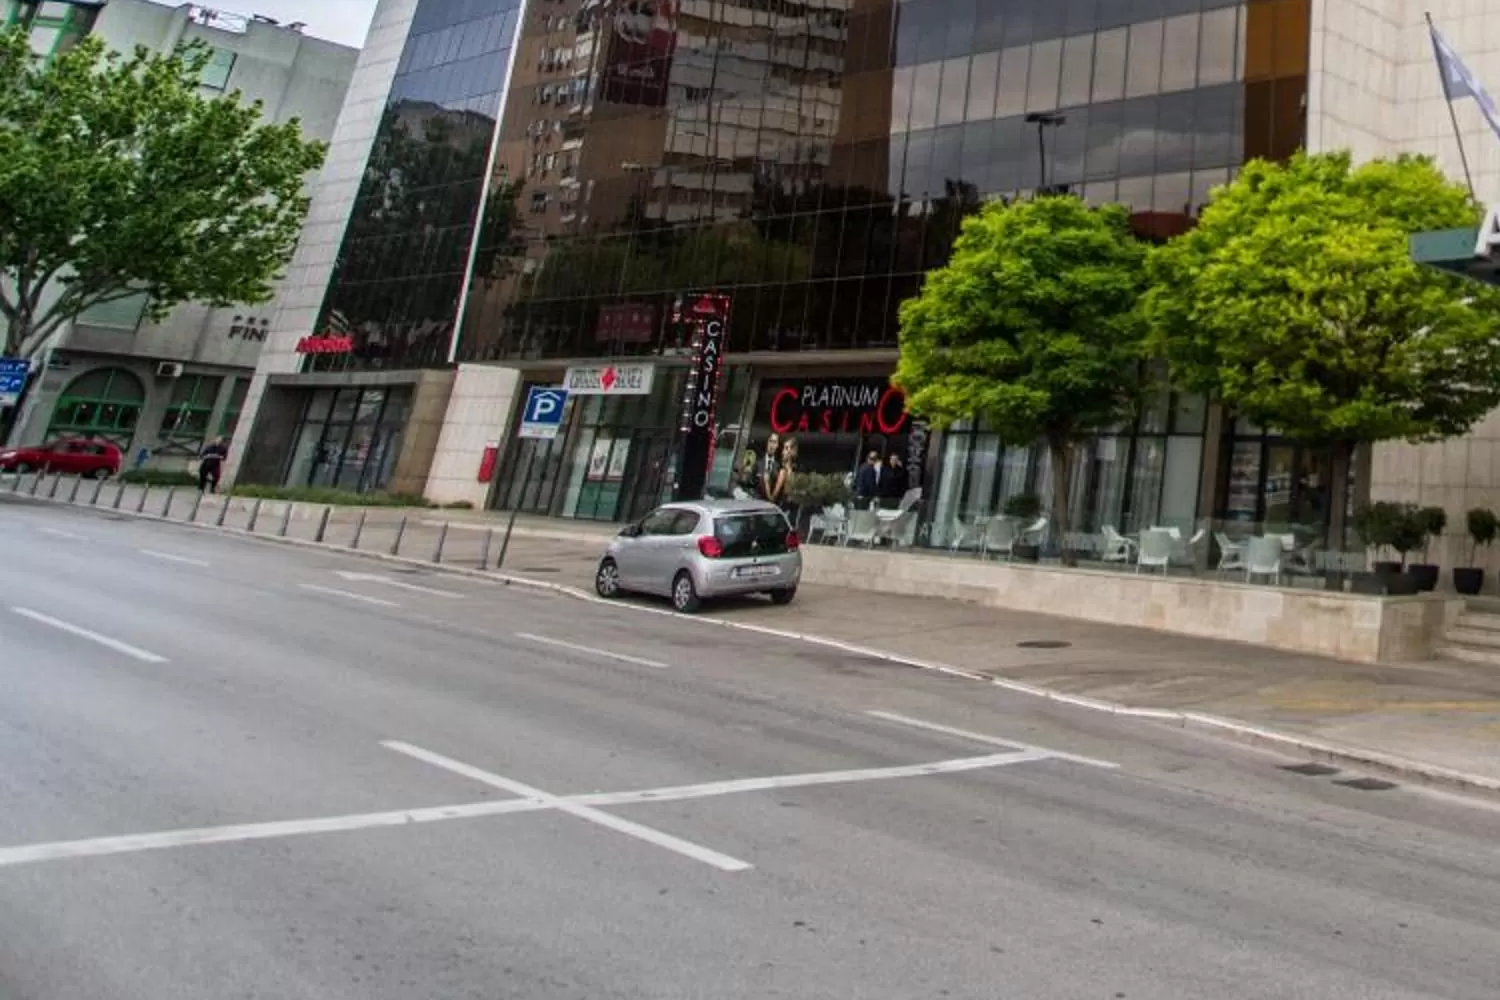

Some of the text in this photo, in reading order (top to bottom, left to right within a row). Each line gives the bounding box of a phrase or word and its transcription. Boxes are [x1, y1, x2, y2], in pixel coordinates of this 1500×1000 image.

[694, 321, 721, 427] CASINO
[532, 399, 556, 420] P
[770, 384, 910, 434] CASINO
[801, 384, 880, 407] PLATINUM
